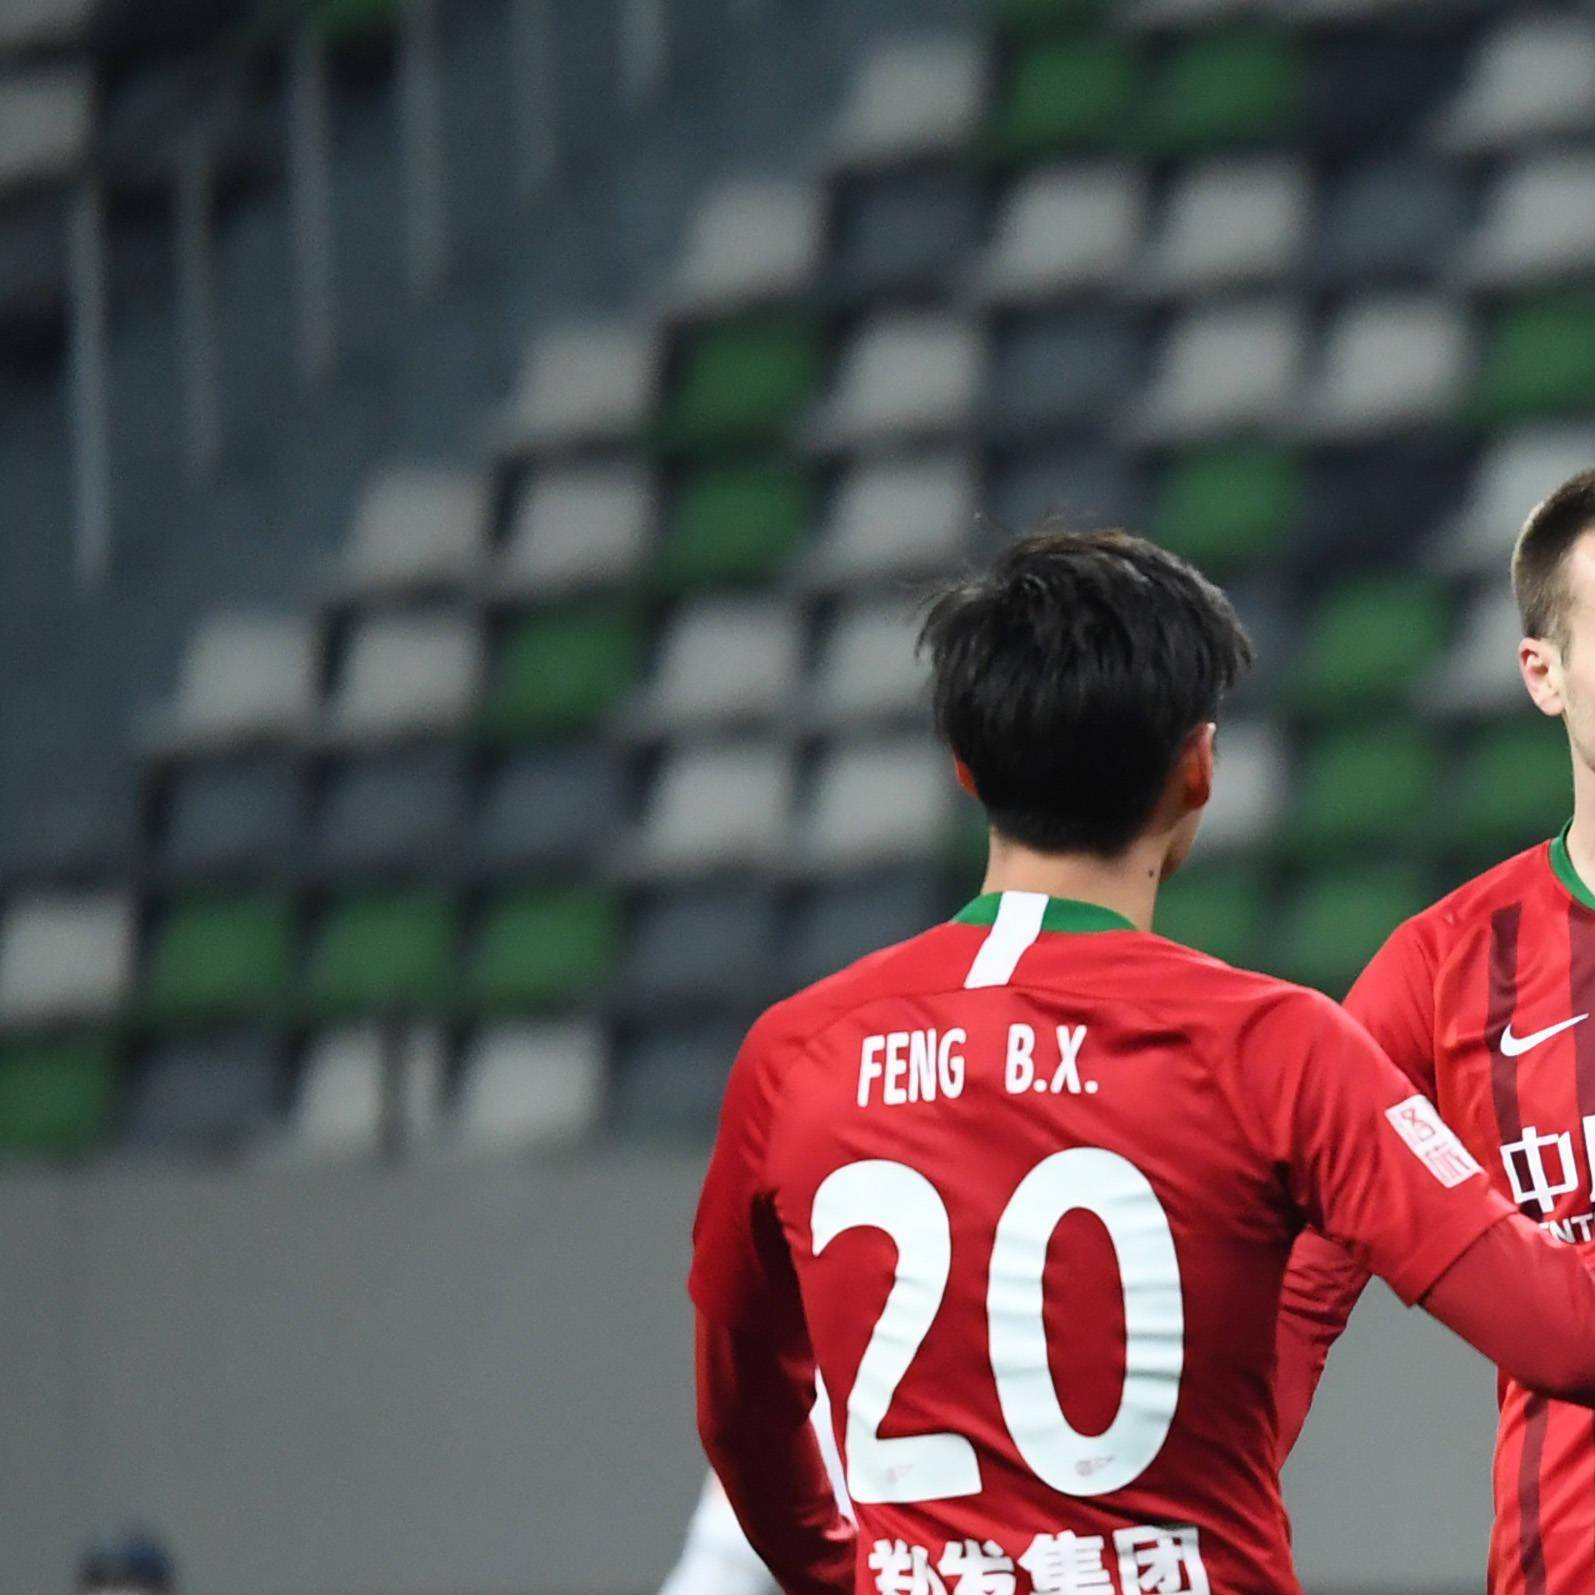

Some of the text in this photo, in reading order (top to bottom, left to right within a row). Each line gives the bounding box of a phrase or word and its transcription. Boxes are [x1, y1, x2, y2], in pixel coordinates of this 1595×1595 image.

[857, 1023, 1099, 1107] FENG B.X.
[810, 1147, 1184, 1505] 20
